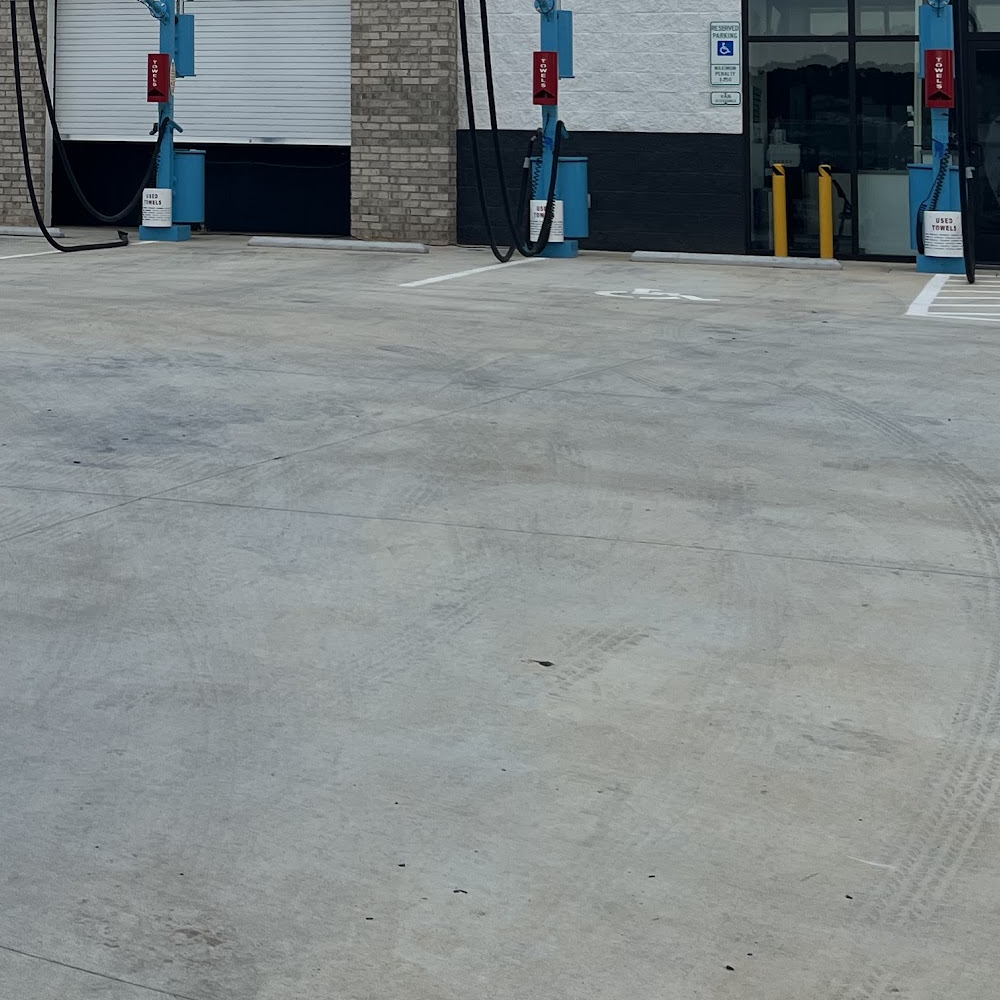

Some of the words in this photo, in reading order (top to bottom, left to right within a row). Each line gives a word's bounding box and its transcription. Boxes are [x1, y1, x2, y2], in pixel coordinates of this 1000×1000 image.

[151, 59, 159, 87] TOWELS
[539, 58, 548, 88] TOWELS
[934, 57, 944, 90] TOWELS
[931, 224, 957, 232] TOWELS
